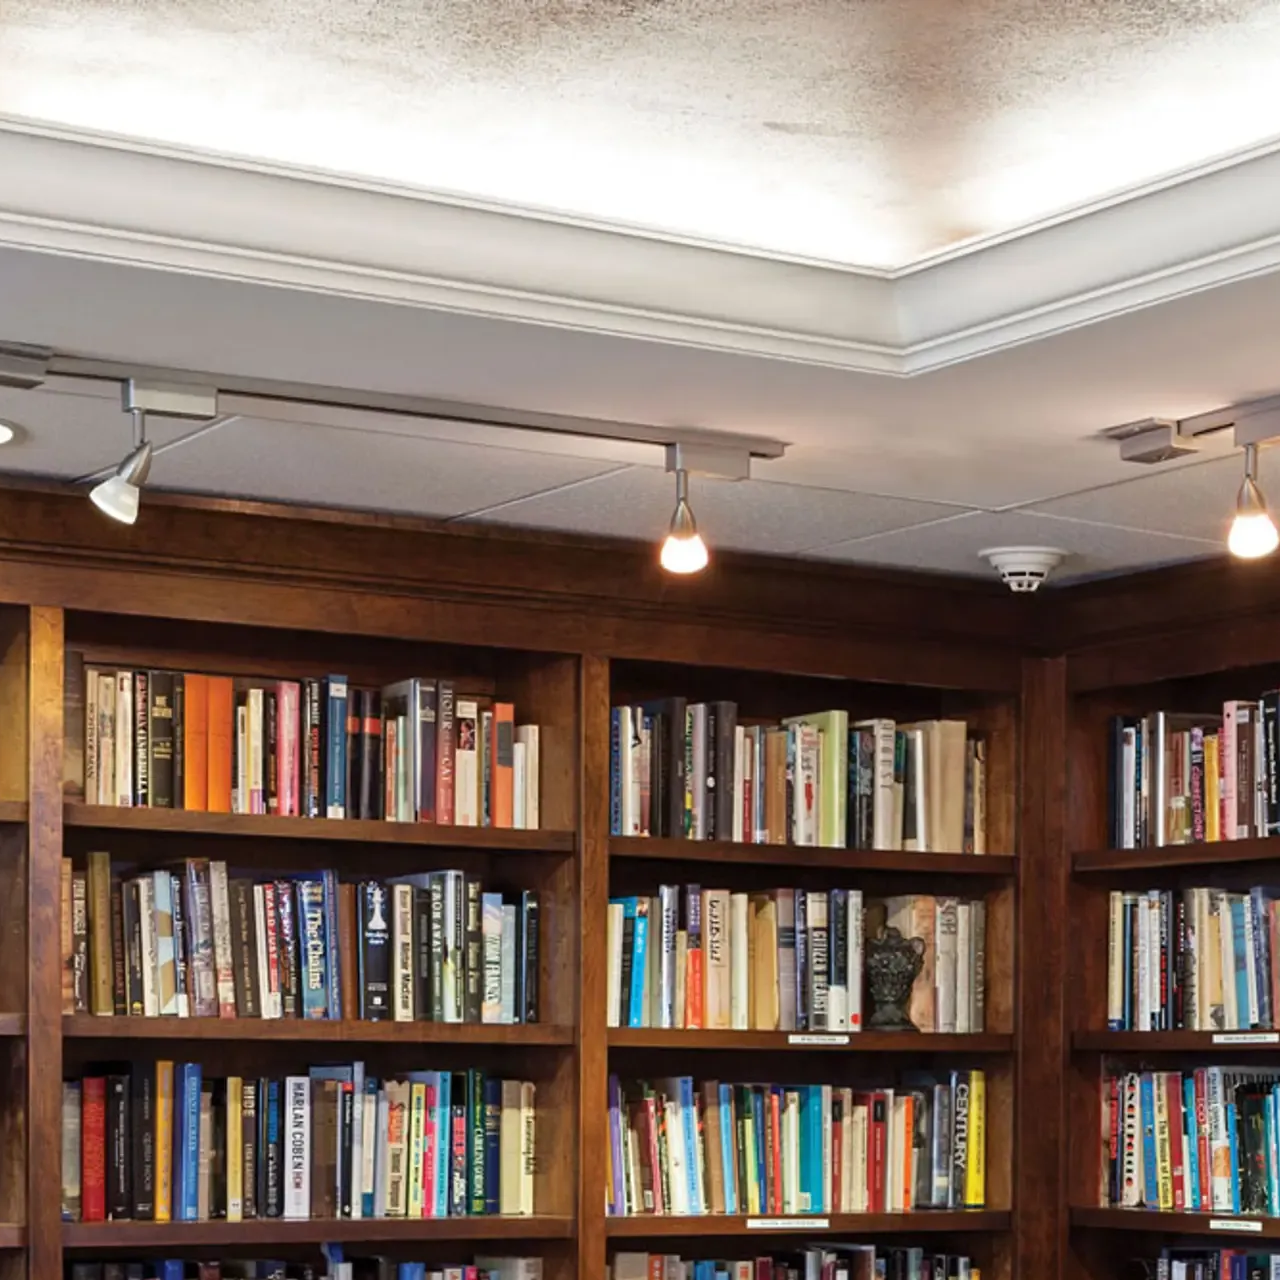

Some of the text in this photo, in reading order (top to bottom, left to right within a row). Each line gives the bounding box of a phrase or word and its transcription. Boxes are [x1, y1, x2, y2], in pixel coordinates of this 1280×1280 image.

[308, 910, 323, 988] The Chains
[292, 1082, 304, 1170] HARLAN COBEN
[955, 1085, 968, 1168] CENTURY
